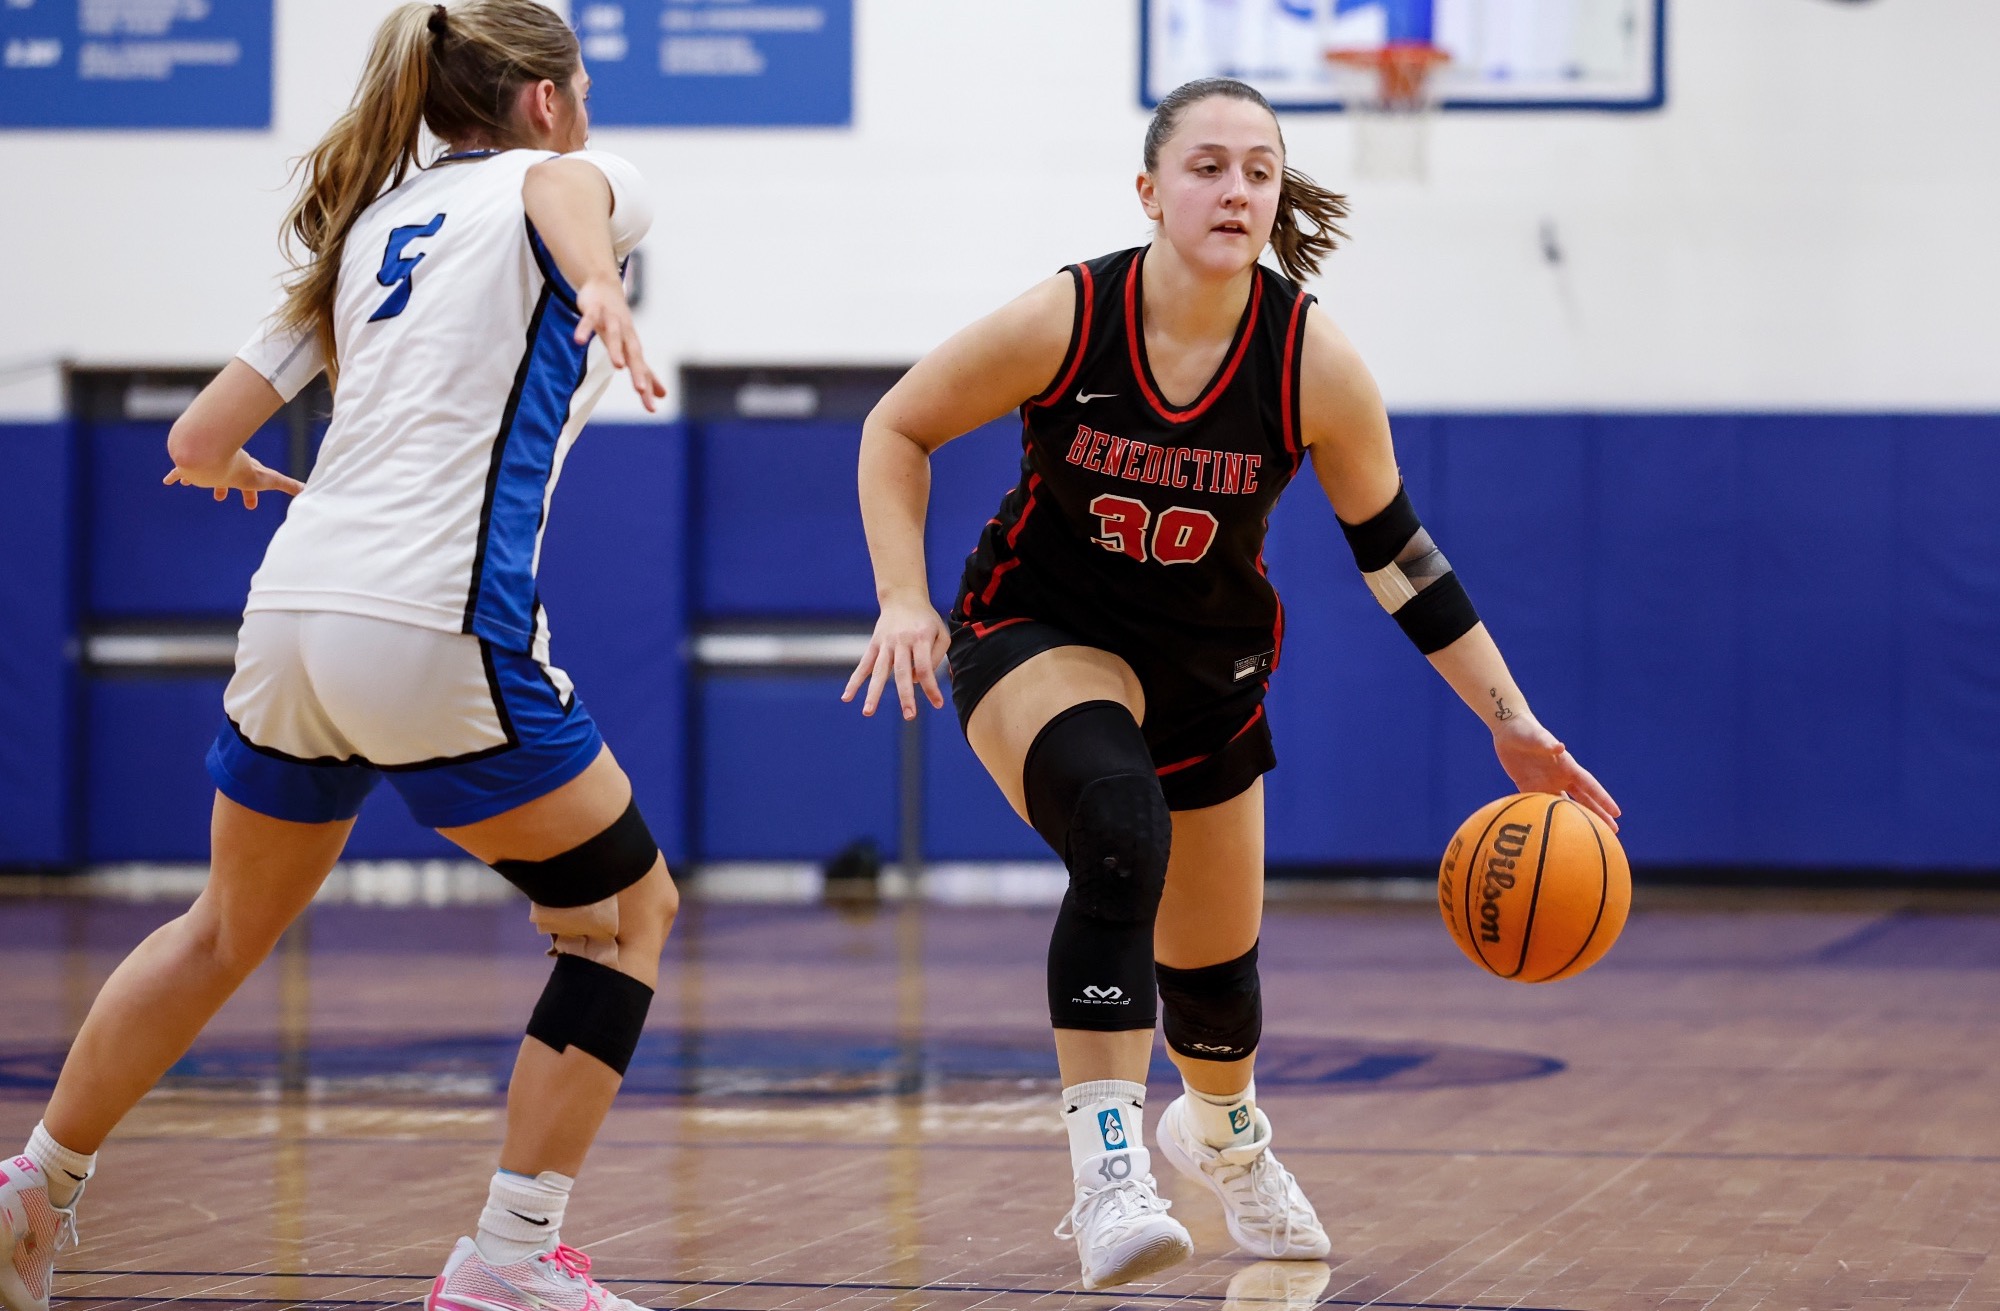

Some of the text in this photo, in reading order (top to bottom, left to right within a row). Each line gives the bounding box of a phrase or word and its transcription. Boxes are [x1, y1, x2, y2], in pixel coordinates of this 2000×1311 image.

[367, 212, 447, 324] 5
[1066, 424, 1262, 494] BENEDICTINE
[1089, 493, 1219, 566] 30
[1481, 822, 1534, 944] Wilson
[13, 1156, 39, 1173] GT
